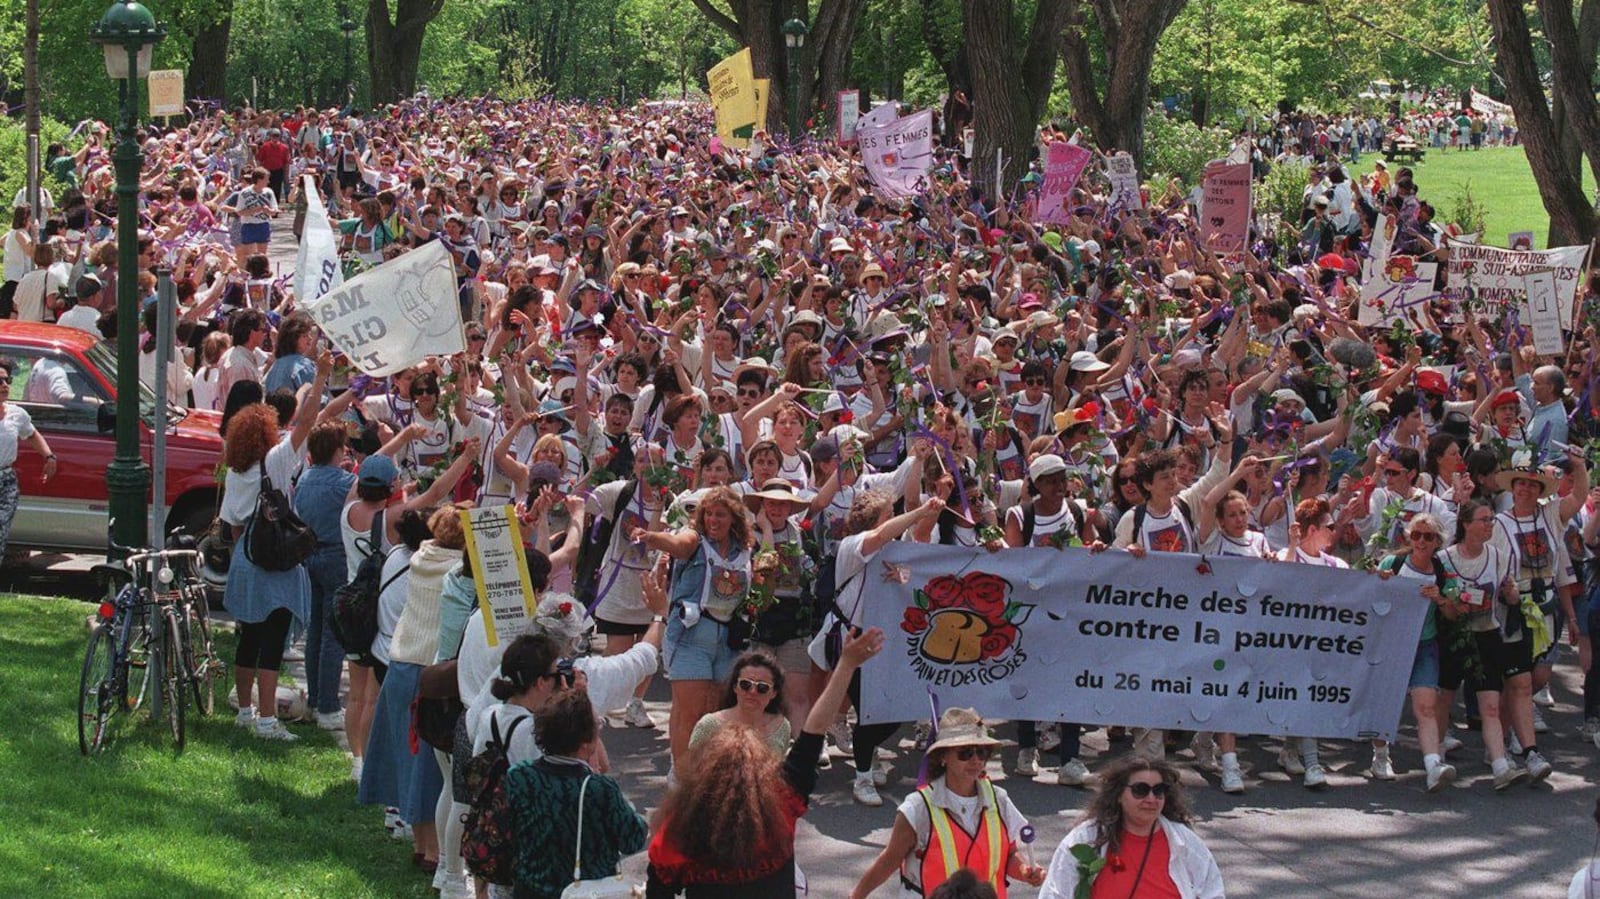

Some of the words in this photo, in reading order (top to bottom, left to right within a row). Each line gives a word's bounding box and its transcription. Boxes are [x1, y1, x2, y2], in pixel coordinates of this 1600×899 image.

[885, 127, 929, 146] FEMMES
[1085, 584, 1189, 610] Marche
[1200, 591, 1247, 615] des
[1259, 595, 1368, 626] femmes
[1078, 618, 1180, 642] contre
[1194, 622, 1221, 645] la
[1235, 630, 1366, 656] pauvreté
[910, 657, 937, 680] PAIN
[934, 669, 951, 686] ET
[951, 668, 977, 687] DES
[978, 648, 1028, 685] ROSES
[1075, 670, 1104, 689] du
[1114, 672, 1140, 691] 26
[1151, 676, 1192, 695] mai
[1202, 681, 1228, 697] au
[1238, 681, 1250, 698] 4
[1256, 681, 1298, 704] juin
[1308, 685, 1351, 703] 1995
